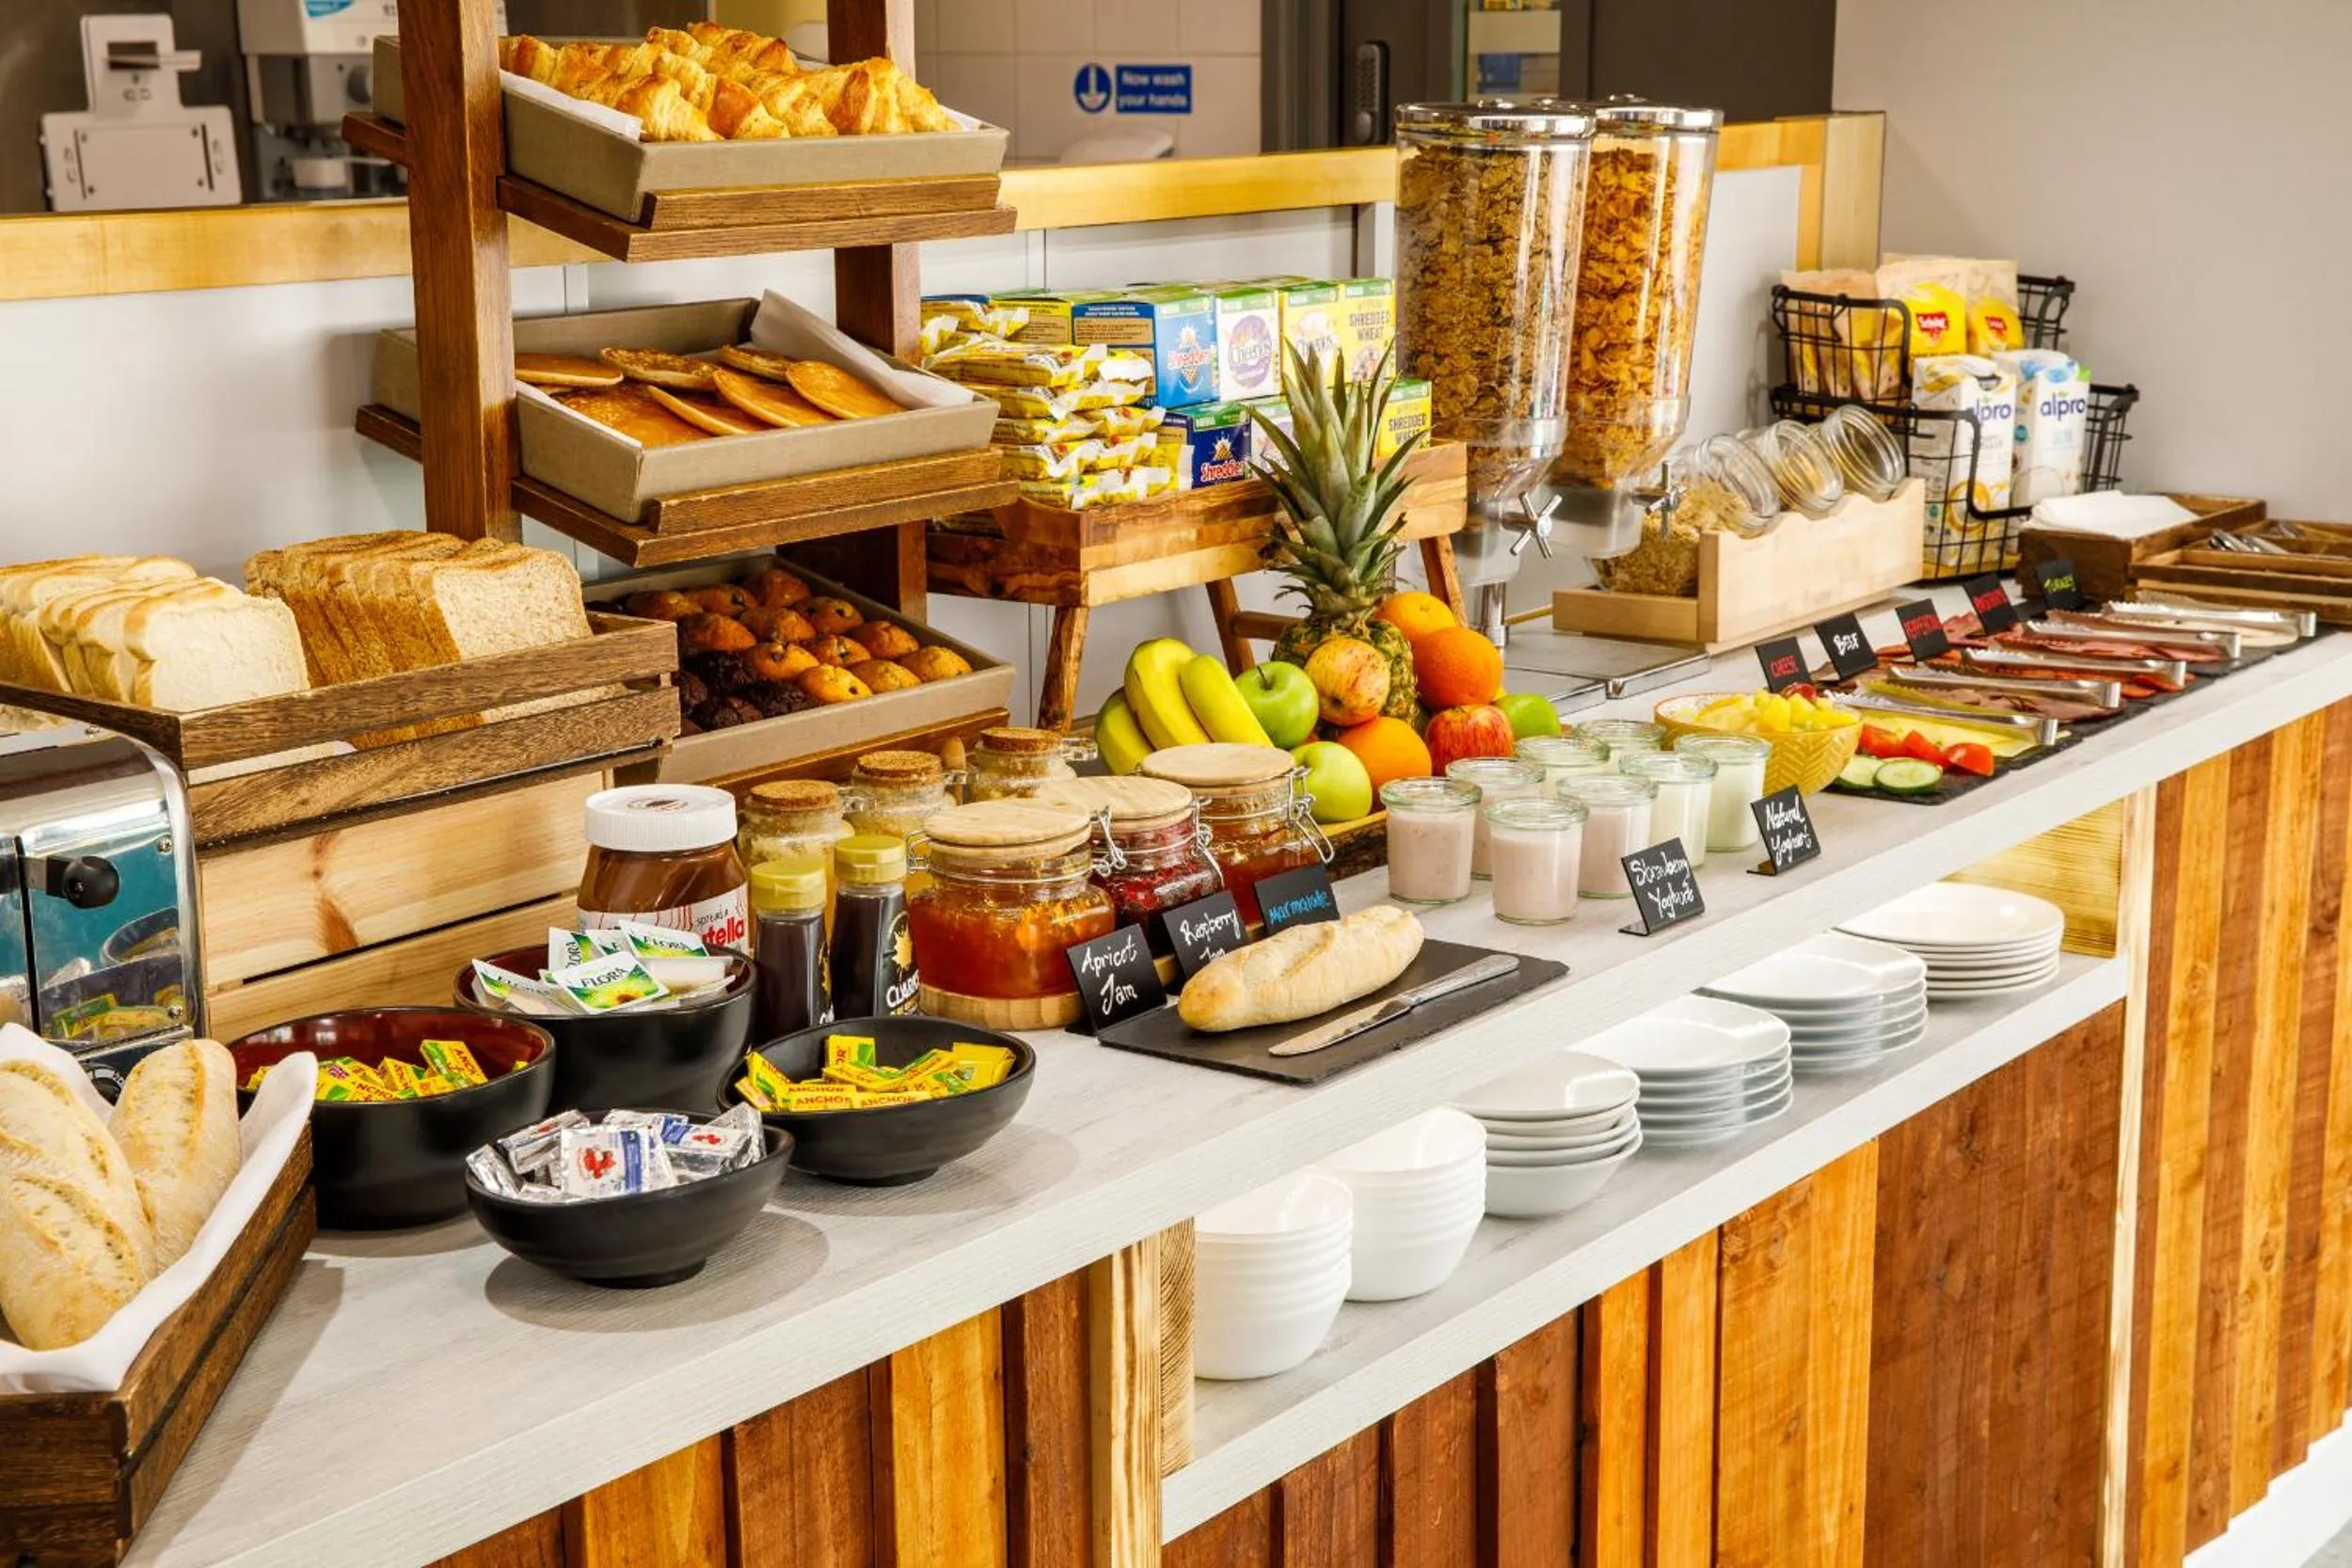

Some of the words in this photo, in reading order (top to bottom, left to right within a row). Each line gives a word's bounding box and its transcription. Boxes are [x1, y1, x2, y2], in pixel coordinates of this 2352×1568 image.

[1121, 71, 1150, 87] Now
[1152, 71, 1186, 87] wash
[1119, 95, 1145, 108] your
[1148, 92, 1187, 107] hands
[1349, 311, 1391, 326] SHREDDED
[1357, 326, 1386, 341] WHEAT
[1969, 399, 2011, 421] lpro
[2041, 393, 2086, 420] alpro
[1389, 413, 1427, 431] SHREDDED
[1765, 795, 1806, 831] Natural
[1081, 933, 1137, 978] Apricot
[580, 966, 628, 988] FLORA
[1100, 973, 1137, 1015] Jam
[796, 1095, 852, 1106] ANCHOR
